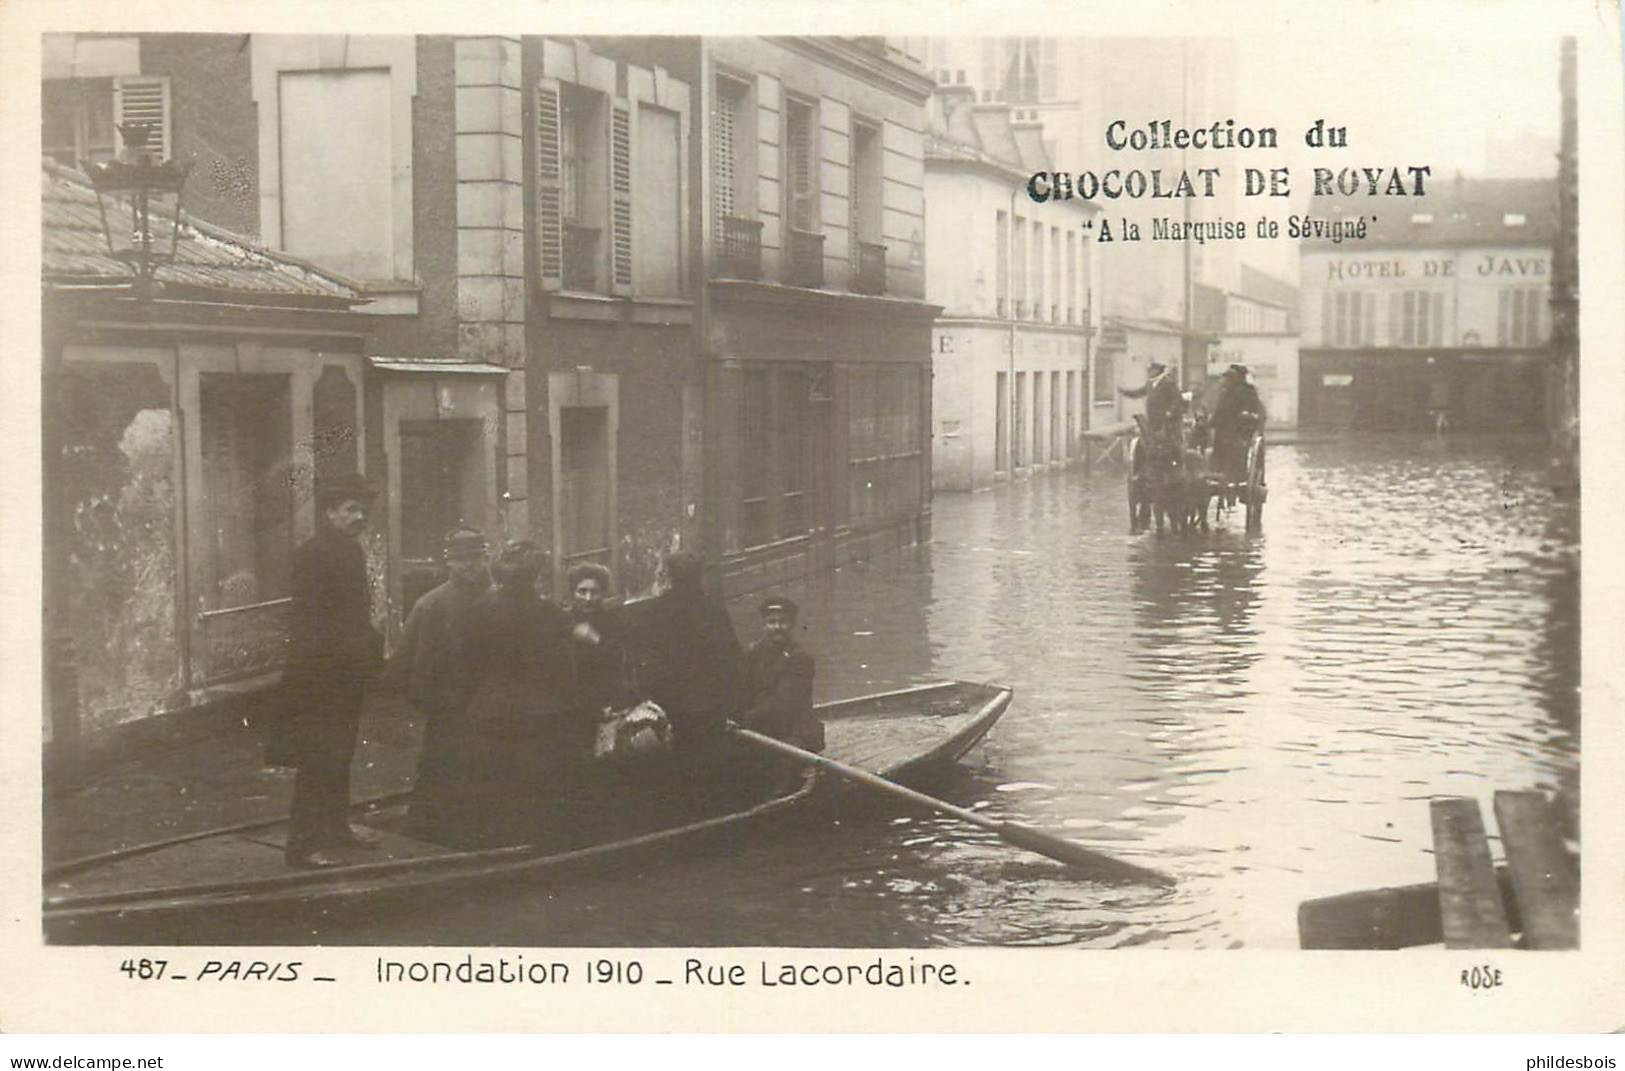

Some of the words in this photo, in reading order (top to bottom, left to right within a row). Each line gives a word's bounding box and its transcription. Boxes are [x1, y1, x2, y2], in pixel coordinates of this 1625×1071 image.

[1328, 259, 1406, 279] HOTEL
[1423, 260, 1456, 276] DE
[1477, 255, 1547, 276] JAVE
